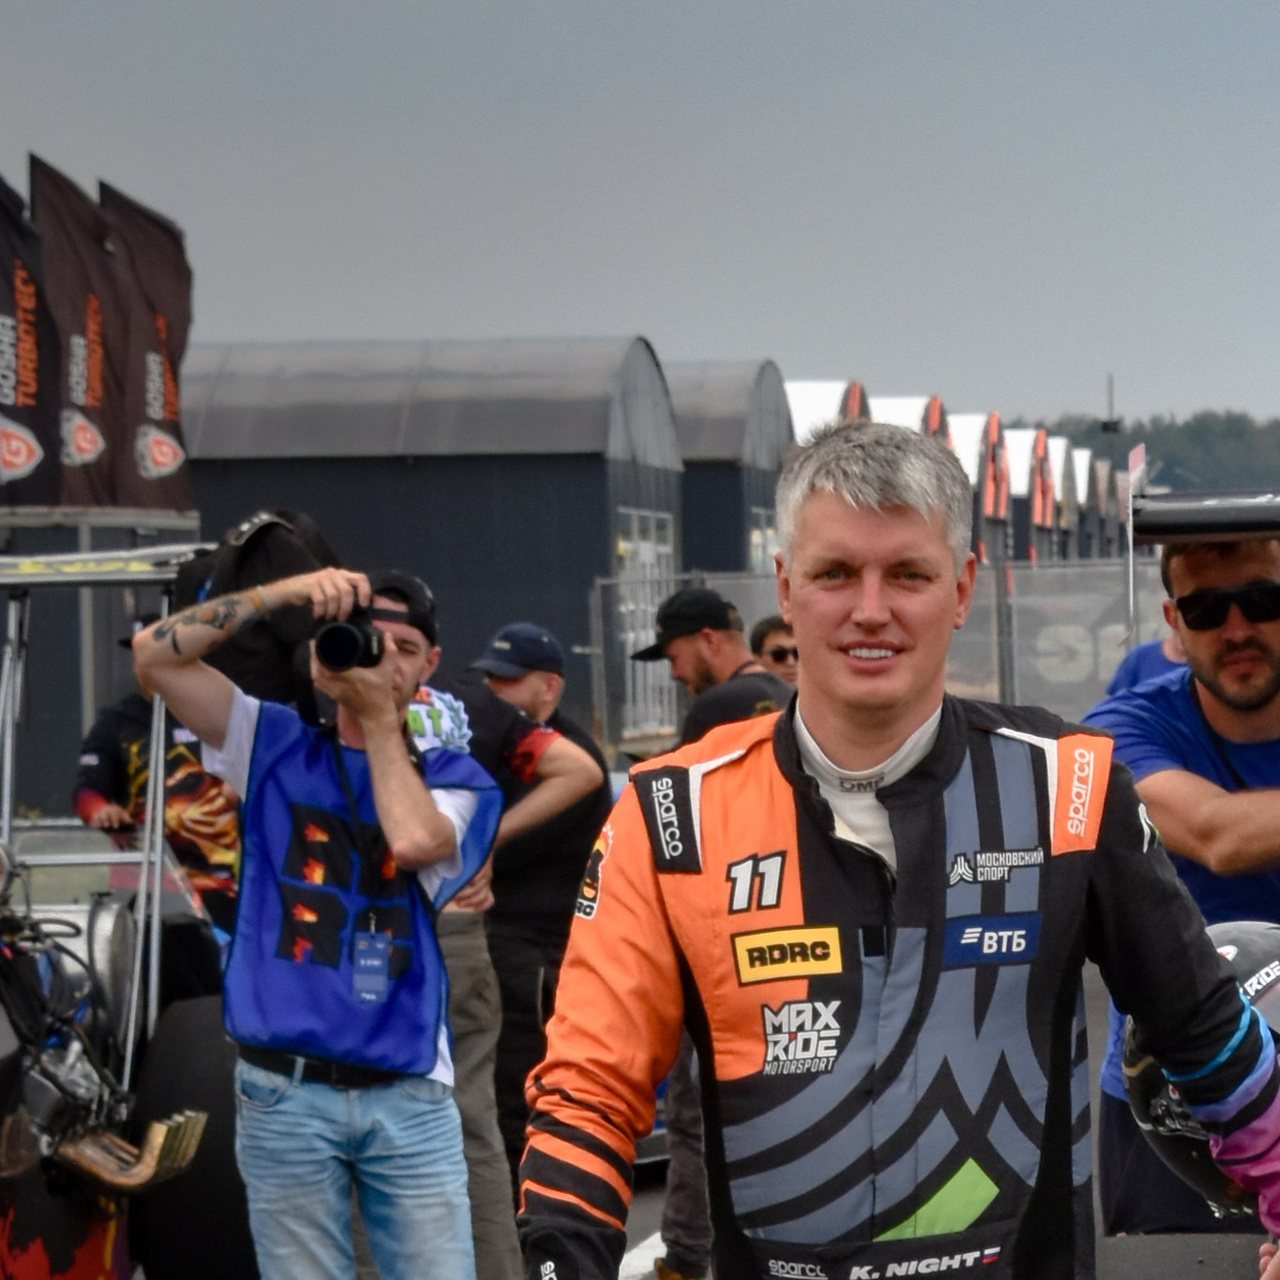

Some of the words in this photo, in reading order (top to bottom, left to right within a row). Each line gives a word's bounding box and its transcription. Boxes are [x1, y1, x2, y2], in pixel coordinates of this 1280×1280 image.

[1066, 748, 1095, 837] sparco
[652, 777, 684, 860] sparco
[976, 847, 1044, 867] МОСКОВСКИЙ
[729, 853, 783, 912] 11
[976, 866, 1010, 881] СПОРТ
[746, 940, 831, 970] RDRC
[982, 929, 1026, 955] ВТБ
[763, 1000, 841, 1035] MAX
[763, 1056, 836, 1076] MOTORSPORT
[849, 1265, 881, 1280] K.
[884, 1251, 981, 1278] NIGHT
